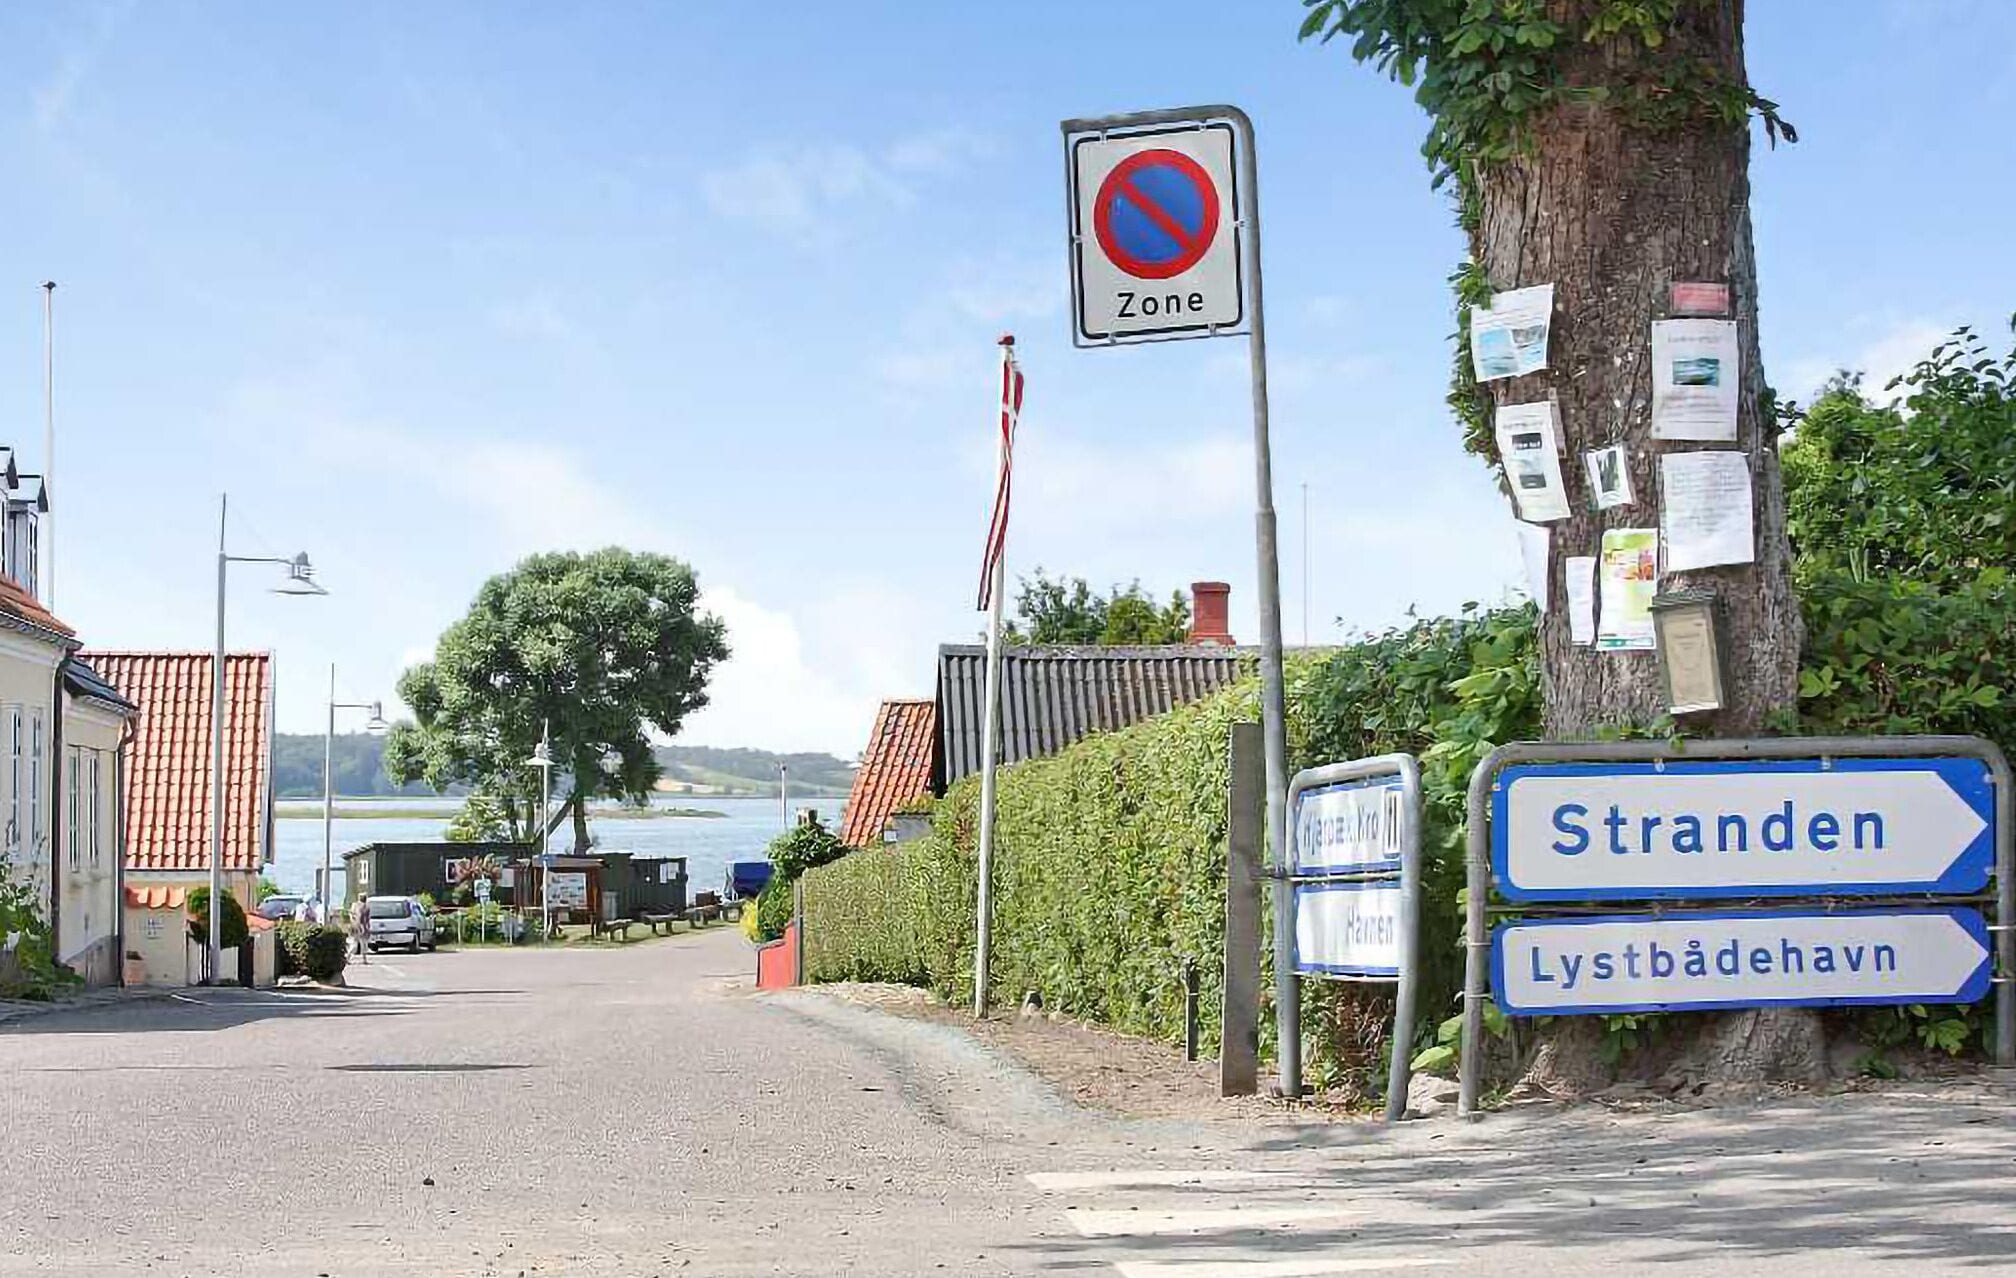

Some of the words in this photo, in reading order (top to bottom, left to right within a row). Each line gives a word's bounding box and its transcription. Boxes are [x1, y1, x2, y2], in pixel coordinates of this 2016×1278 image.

[1118, 292, 1203, 318] Zone
[1551, 800, 1885, 855] Stranden
[1345, 904, 1393, 946] Havnen
[1531, 939, 1897, 989] Lystbådehavn
